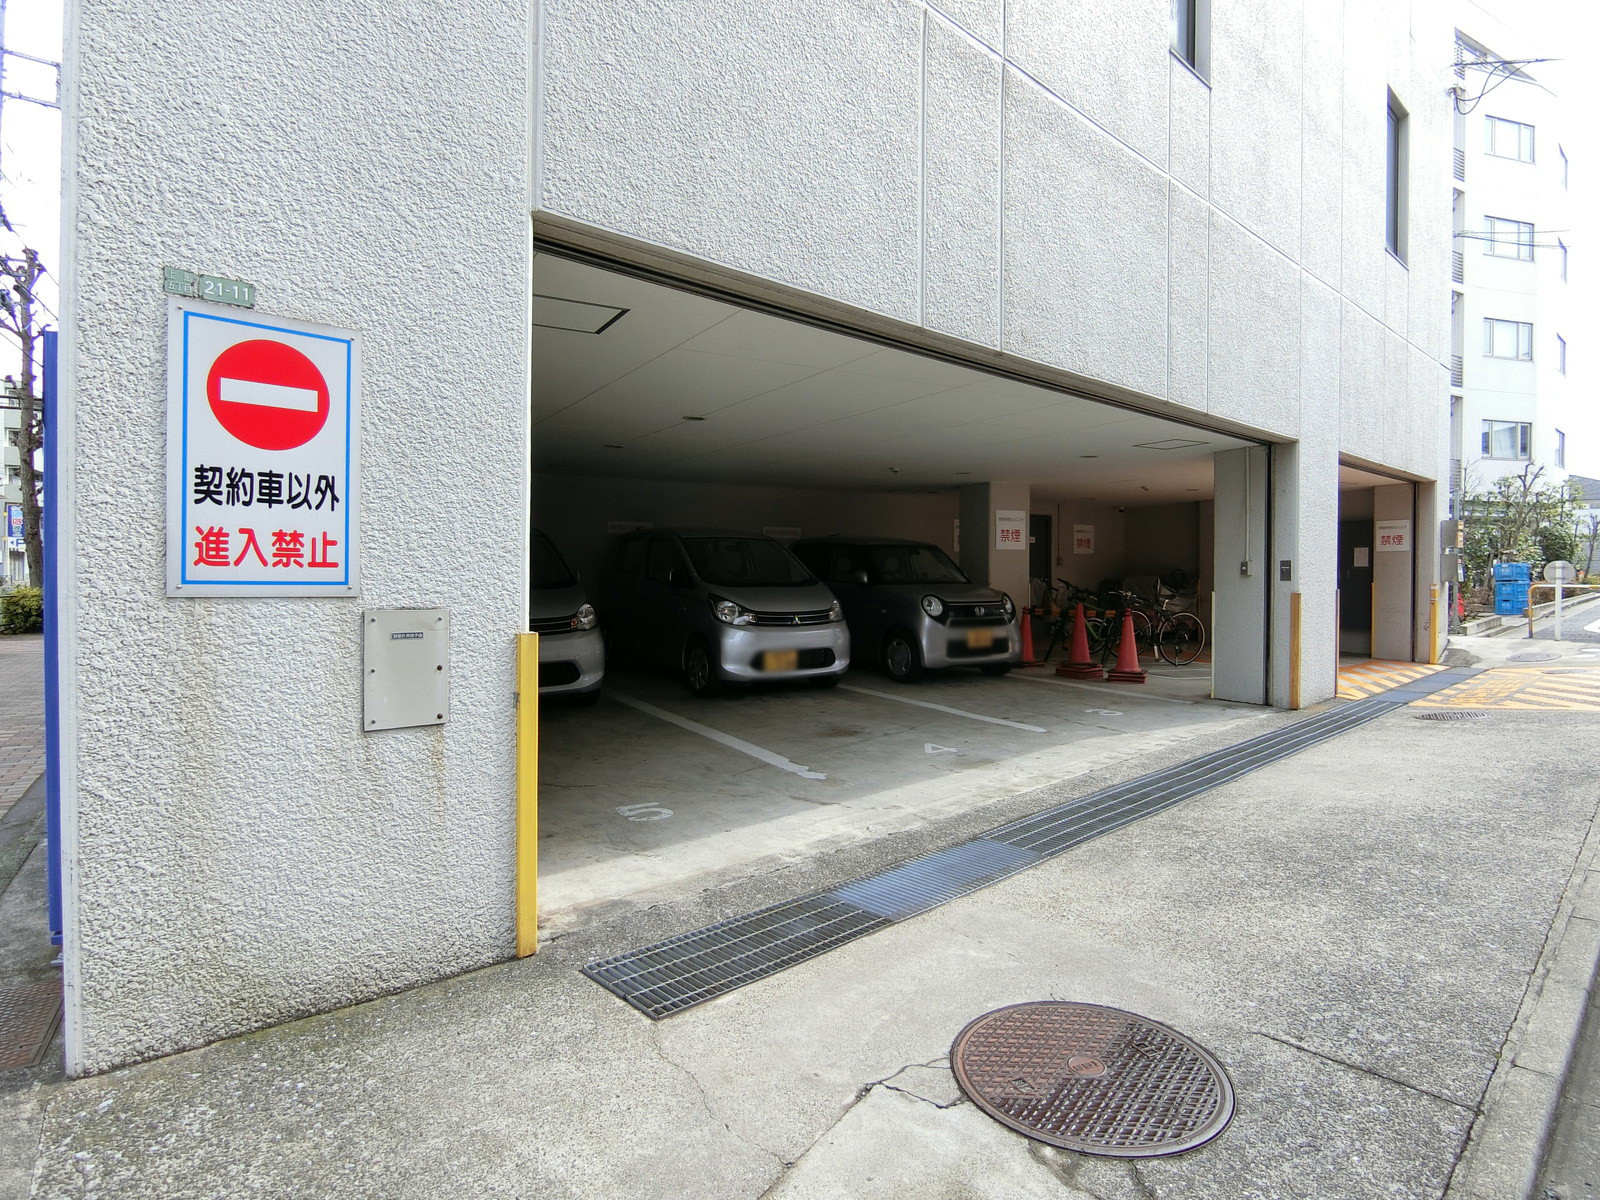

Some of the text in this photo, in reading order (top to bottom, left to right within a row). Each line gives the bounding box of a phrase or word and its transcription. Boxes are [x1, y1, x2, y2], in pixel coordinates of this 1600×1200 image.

[204, 280, 249, 301] 21-11
[193, 463, 340, 512] 契約車以外
[1000, 529, 1021, 542] 禁煙
[1380, 534, 1404, 546] 禁煙
[193, 525, 340, 569] 進入禁止
[923, 743, 958, 754] 4
[615, 802, 674, 821] 5
